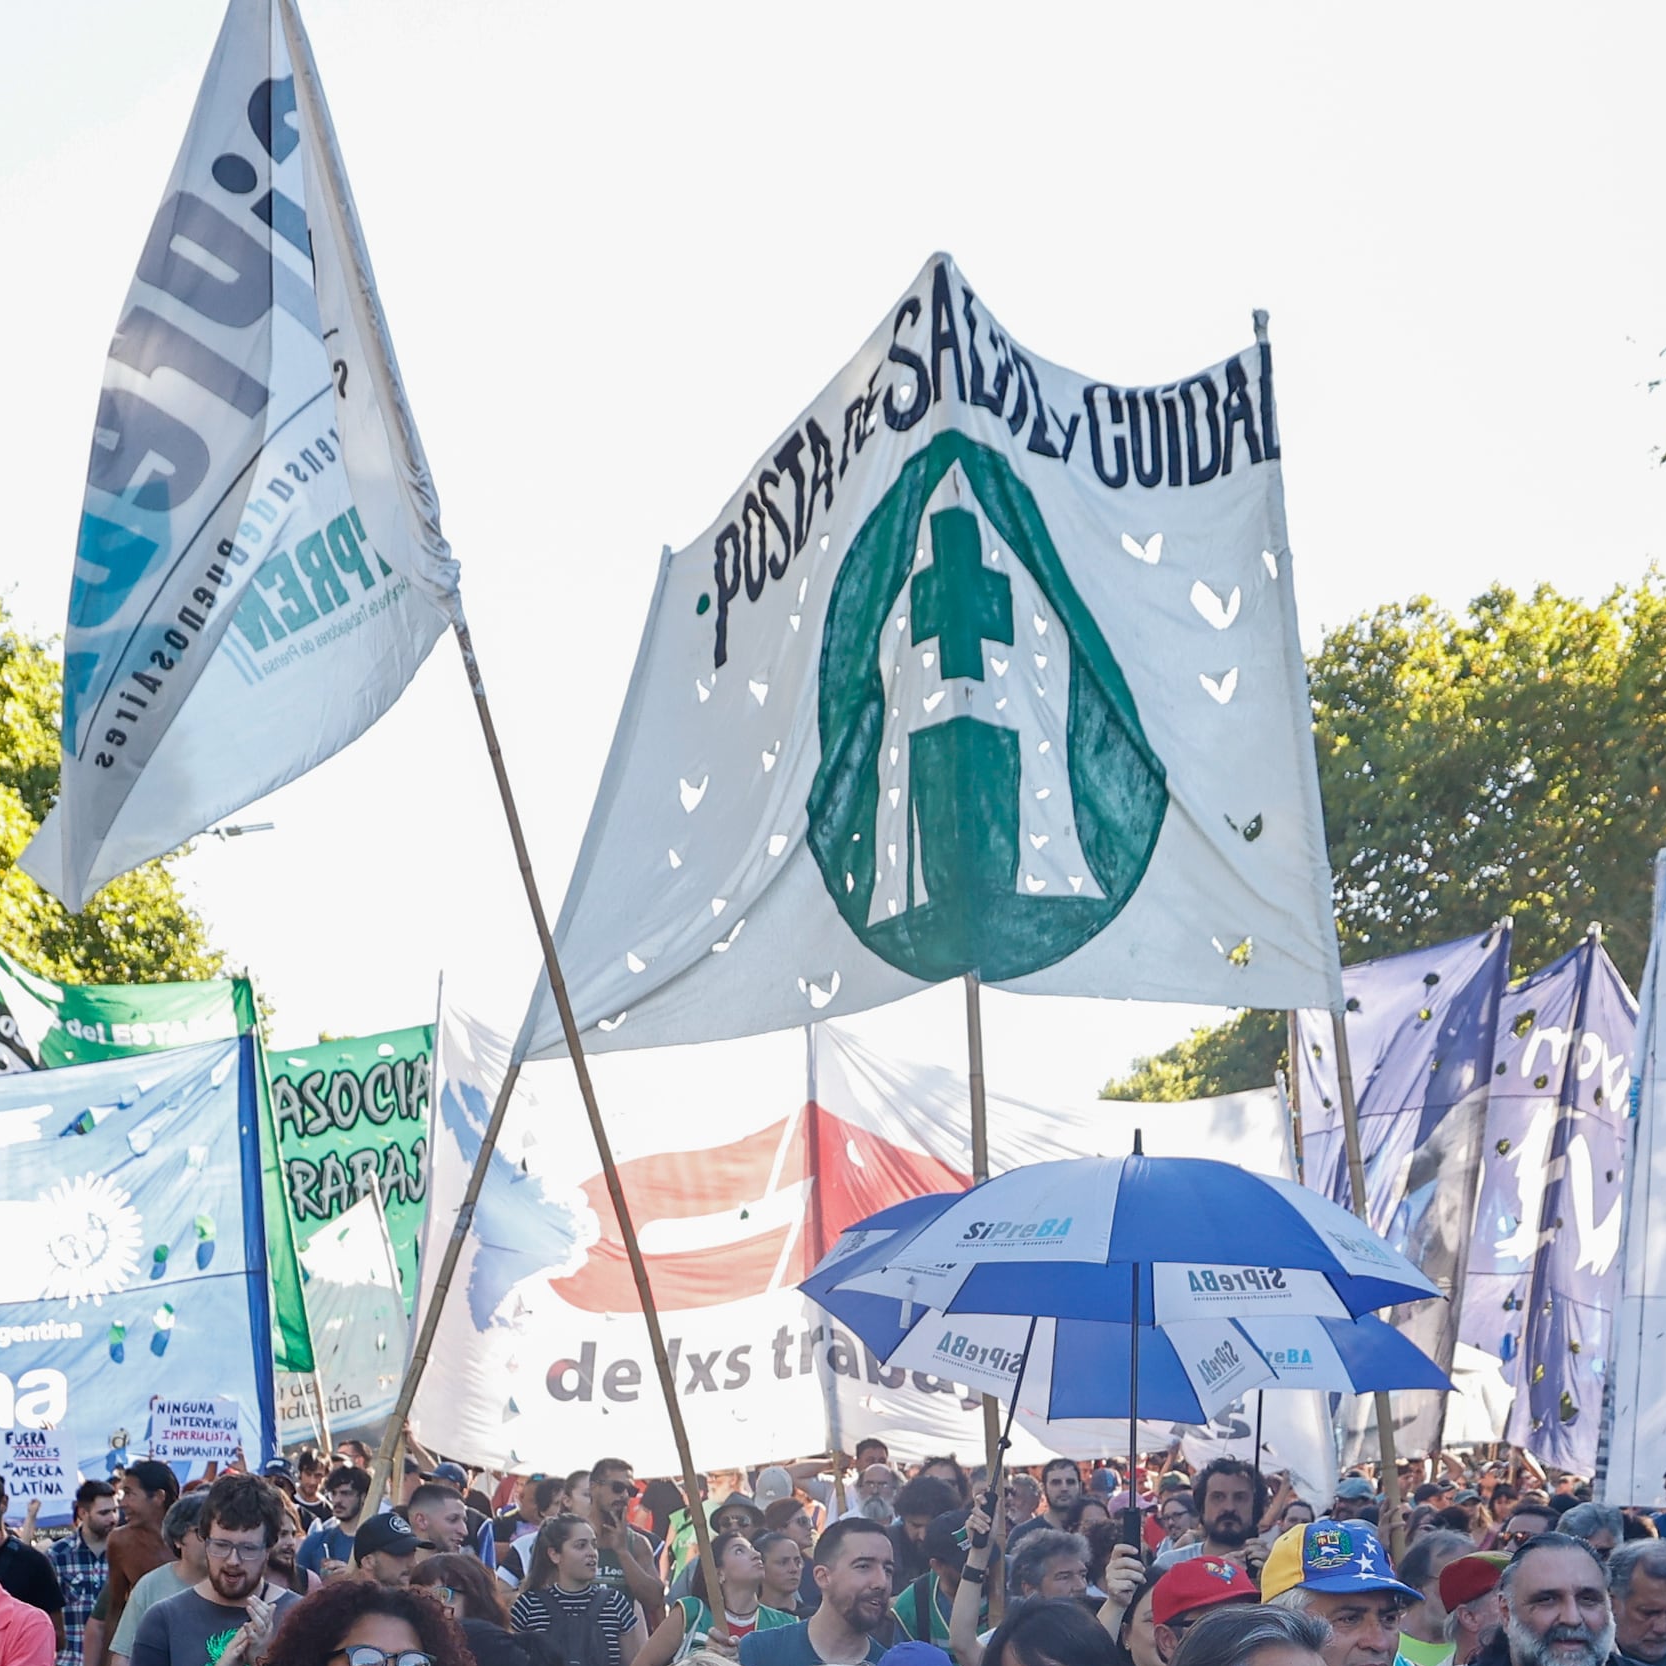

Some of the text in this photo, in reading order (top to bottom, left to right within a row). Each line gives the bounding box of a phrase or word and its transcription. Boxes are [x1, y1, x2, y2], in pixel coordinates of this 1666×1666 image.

[713, 417, 834, 669] POSTA
[273, 1051, 431, 1141] ASOCIA
[963, 1217, 1073, 1241] SiPreBA
[546, 1341, 640, 1402] de
[157, 1402, 215, 1414] NINGUNA
[5, 1431, 46, 1447] FUERA
[162, 1430, 232, 1442] IMPERIALISTA
[13, 1447, 60, 1458] YANKEES
[156, 1444, 167, 1455] ES
